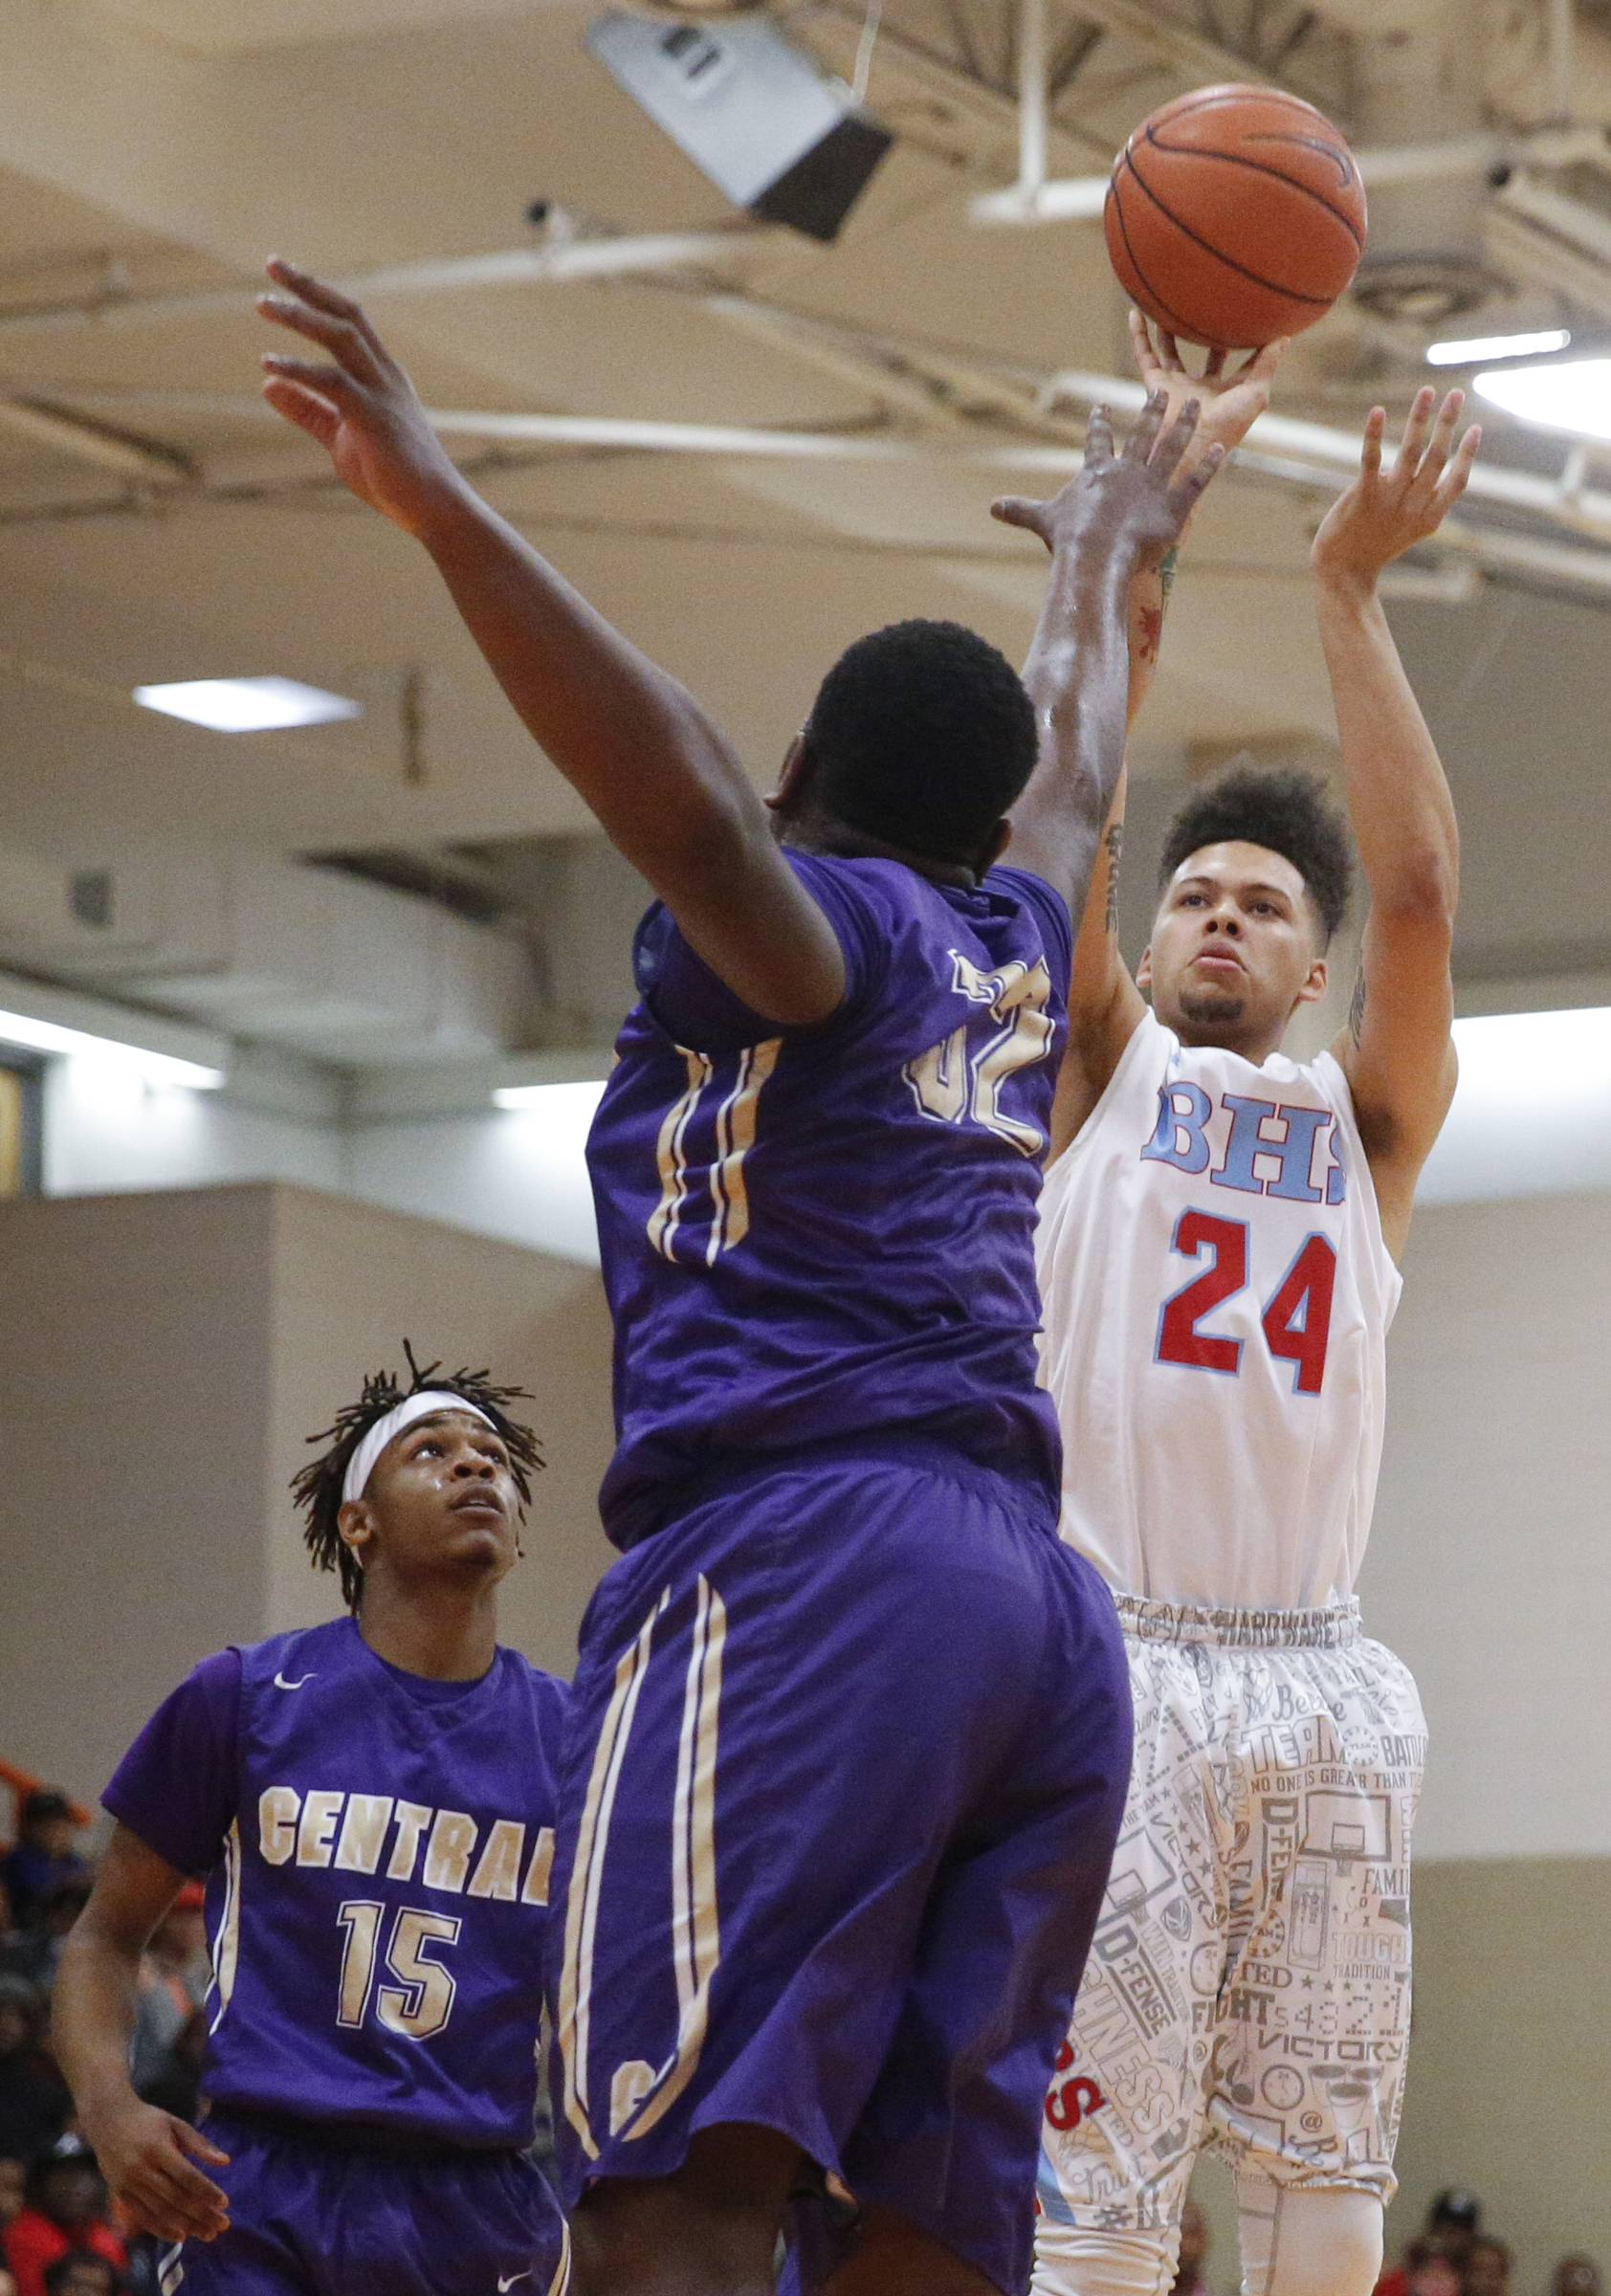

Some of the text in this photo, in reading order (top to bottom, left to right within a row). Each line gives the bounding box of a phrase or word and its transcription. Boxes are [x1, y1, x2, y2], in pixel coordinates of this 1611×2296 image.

[1153, 1205, 1337, 1398] 24
[1250, 1778, 1269, 1794] NO
[1277, 1776, 1302, 1792] ONE
[1304, 1771, 1314, 1787] IS
[1374, 1771, 1406, 1789] THAN
[1139, 1920, 1175, 1968] WIN
[1333, 1932, 1407, 1962] TOUGH
[336, 1899, 462, 2042] 15
[1092, 1923, 1172, 2037] D-FENSE
[1334, 1963, 1390, 1980] TRADITION
[1274, 1987, 1404, 2036] 5 4 3 2 1
[1257, 2028, 1403, 2062] VICTORY
